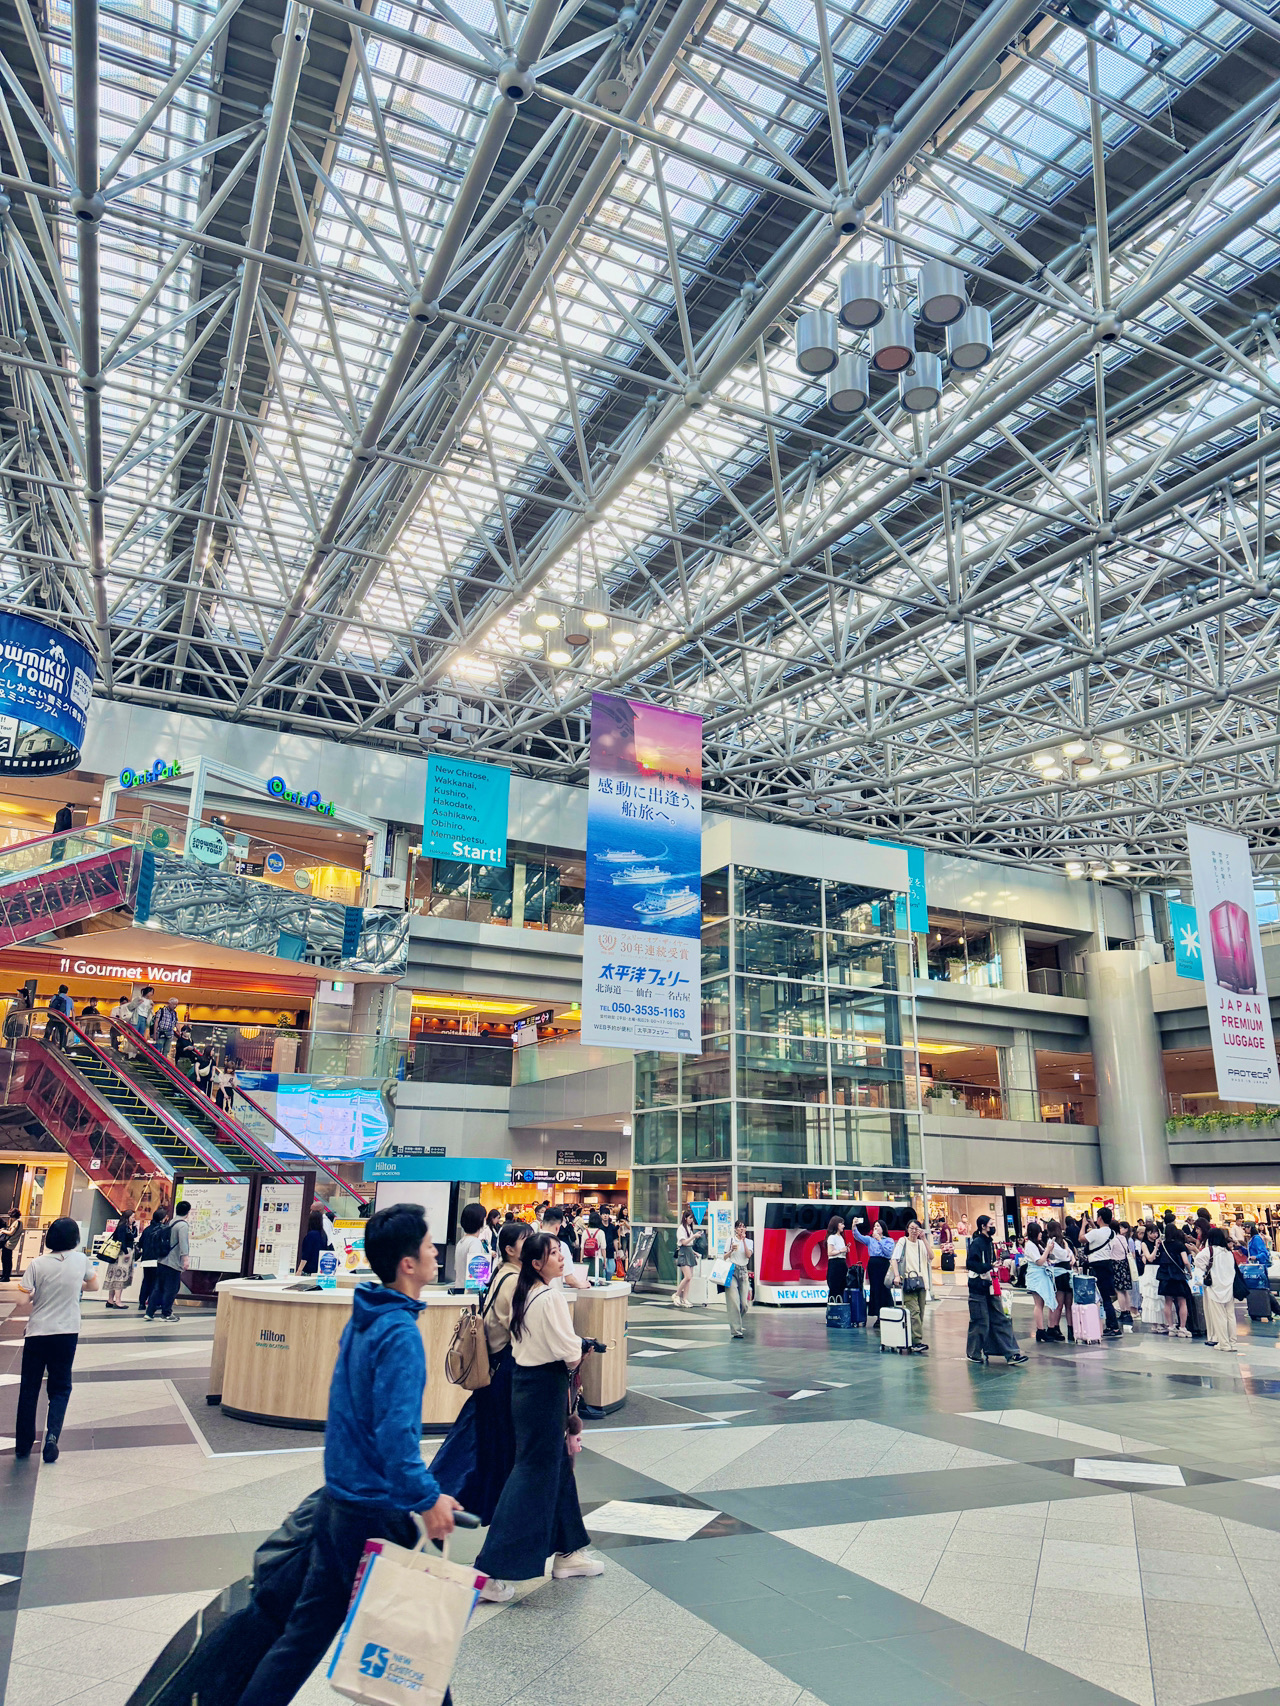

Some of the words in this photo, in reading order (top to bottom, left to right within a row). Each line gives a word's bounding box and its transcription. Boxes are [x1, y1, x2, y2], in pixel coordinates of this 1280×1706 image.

[436, 766, 454, 775] New
[456, 768, 489, 782] Chitose,
[434, 776, 476, 790] Wakkanai,
[434, 786, 468, 800] Kushiro,
[598, 778, 695, 810] 感動に出逢う、
[434, 797, 476, 811] Hakodate,
[432, 808, 480, 822] Asahikawa,
[622, 800, 676, 826] 船旅へ。
[452, 841, 502, 862] Start!
[602, 934, 613, 944] 30
[620, 942, 689, 960] 30年連続受賞
[74, 960, 142, 980] Gourmet
[148, 966, 192, 984] World
[598, 963, 690, 987] 太平洋フェリー
[595, 984, 622, 994] 北海道
[636, 987, 652, 998] 仙台
[668, 991, 690, 1002] 名古屋
[1220, 998, 1261, 1014] JAPAN
[1221, 1015, 1264, 1032] PREMIUM
[1223, 1033, 1266, 1050] LUGGAGE
[376, 1162, 396, 1170] Hilton
[778, 1290, 798, 1299] NEW
[260, 1330, 286, 1342] Hilton
